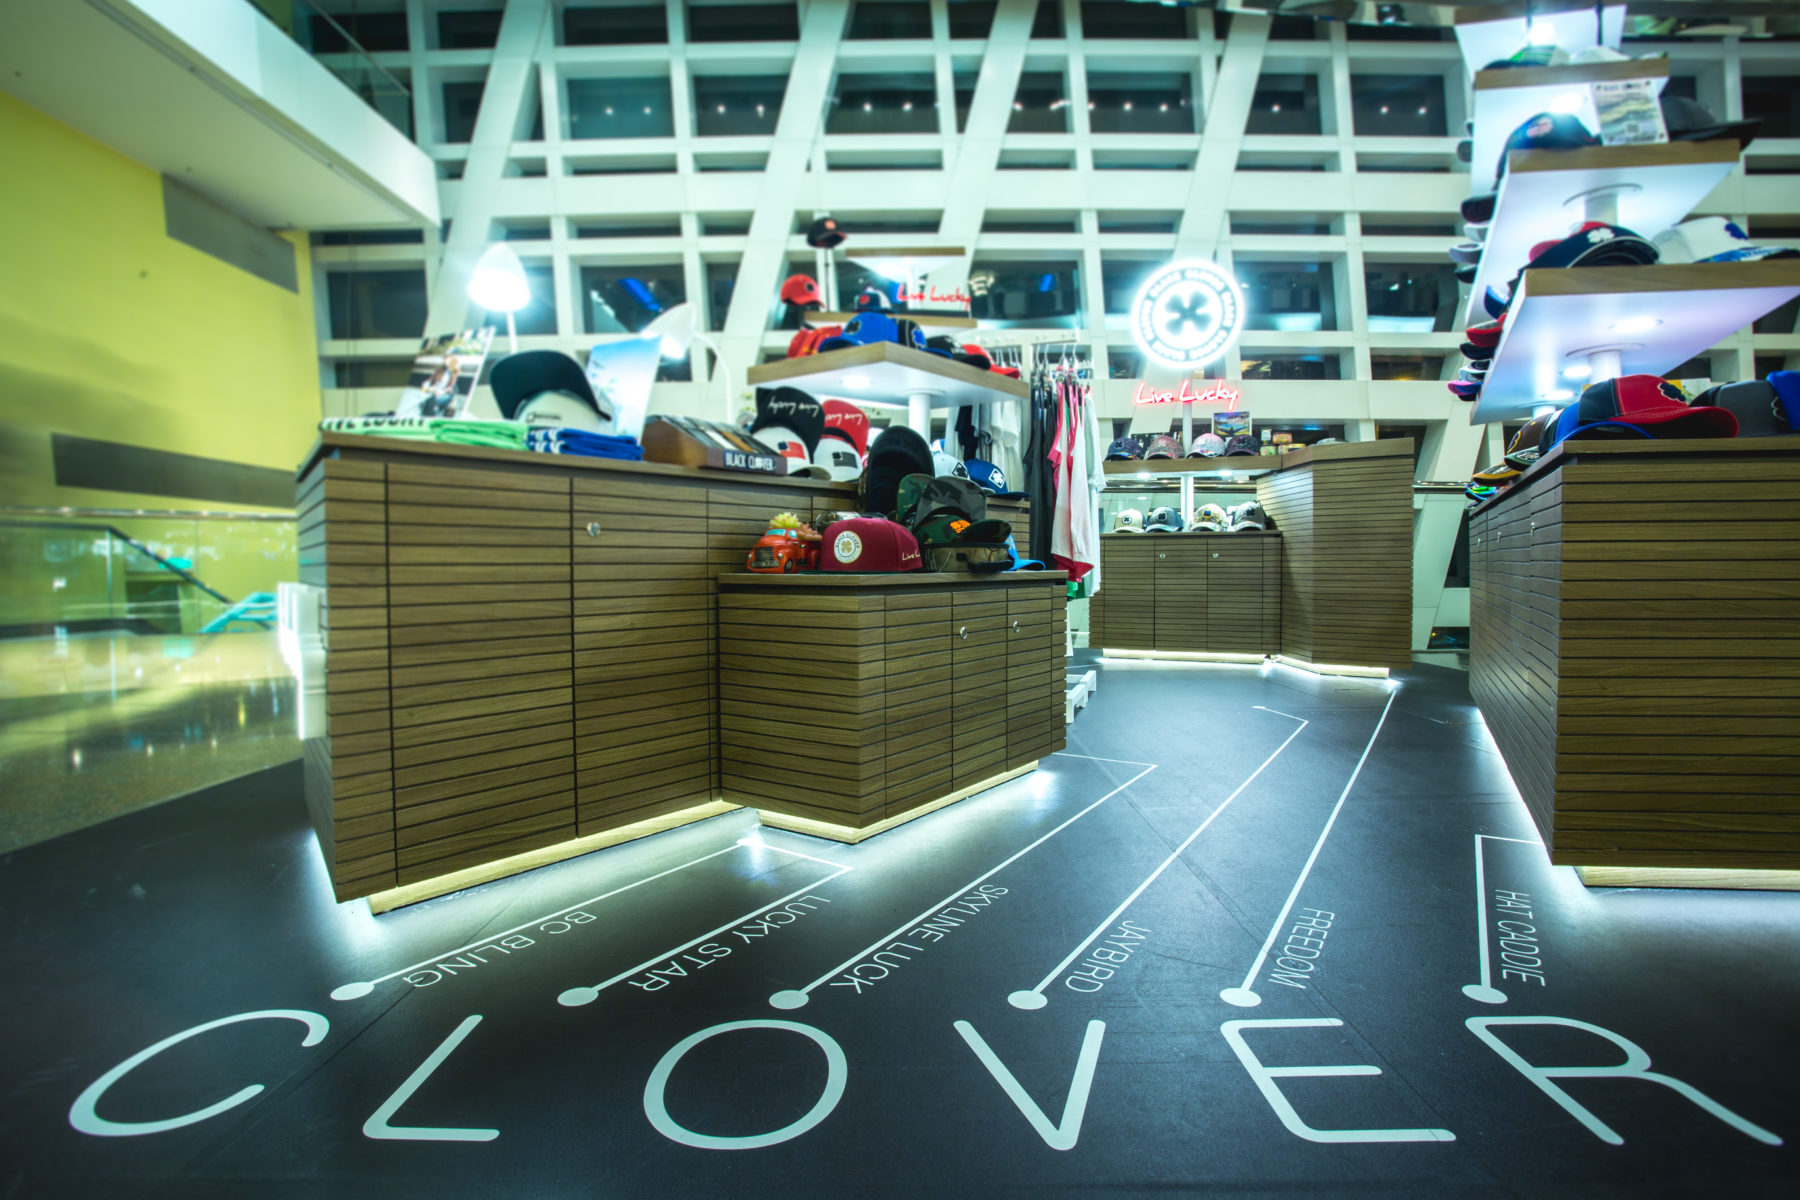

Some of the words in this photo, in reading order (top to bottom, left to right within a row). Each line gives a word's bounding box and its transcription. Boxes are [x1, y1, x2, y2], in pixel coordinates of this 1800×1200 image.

[767, 395, 797, 415] Lucky
[1135, 381, 1174, 404] Live
[1179, 379, 1239, 411] Lucky
[725, 452, 747, 468] BLACK
[540, 911, 598, 935] BC
[733, 895, 830, 944] LUCKY
[908, 884, 1008, 942] SKYLINE
[1495, 889, 1534, 920] HAT
[402, 934, 536, 988] BLING
[628, 943, 732, 991] STAR
[829, 942, 924, 994] LUCK
[1065, 920, 1152, 993] JAYBIRD
[1268, 907, 1335, 989] FREEDOM
[1498, 920, 1546, 987] CADDIE
